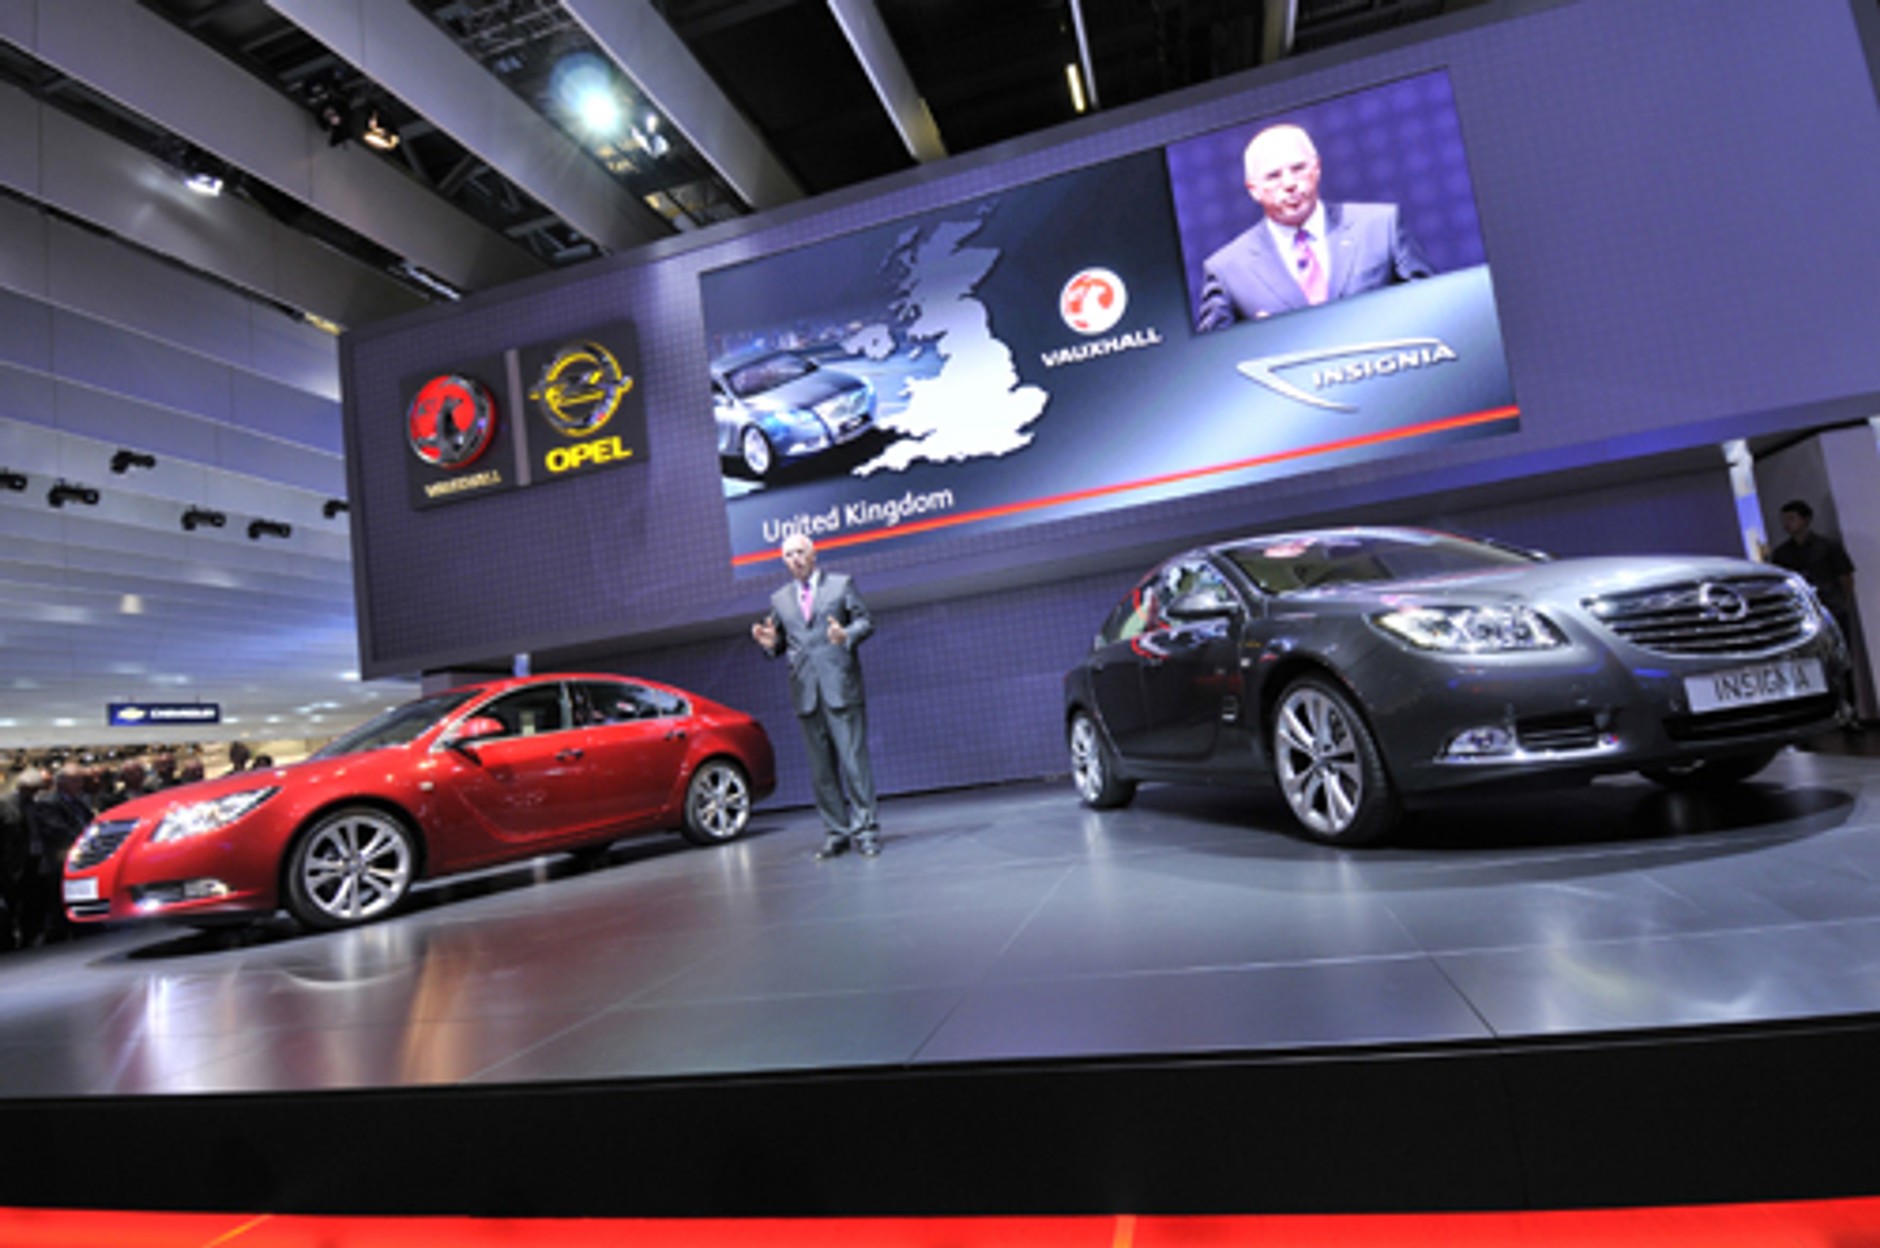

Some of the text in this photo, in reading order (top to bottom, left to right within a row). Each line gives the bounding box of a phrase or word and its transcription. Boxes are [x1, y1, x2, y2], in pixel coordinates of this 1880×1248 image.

[1040, 326, 1162, 367] VAUXHALL
[1311, 345, 1456, 389] INSIGNIA
[544, 436, 632, 472] OPEL
[762, 489, 954, 542] United Kingdom
